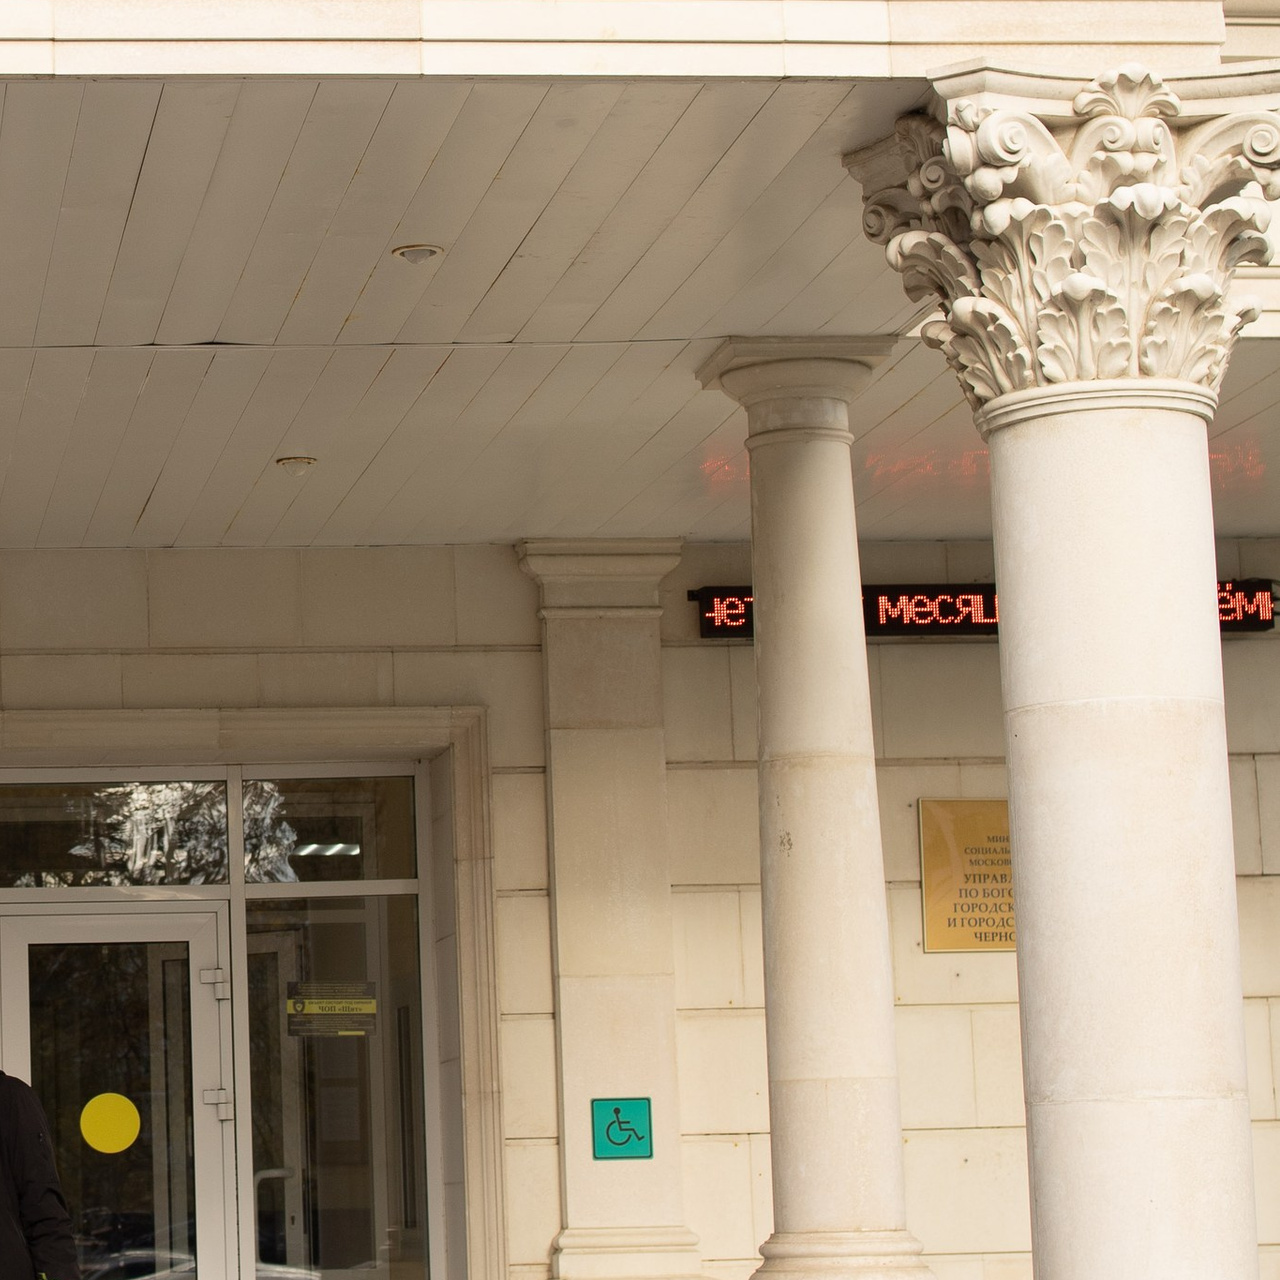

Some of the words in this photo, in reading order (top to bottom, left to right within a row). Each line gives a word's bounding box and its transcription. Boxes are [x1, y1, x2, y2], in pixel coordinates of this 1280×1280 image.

[969, 858, 1012, 866] МОСКОВ
[958, 888, 979, 898] ПО
[953, 903, 1015, 914] ГОРОДСК
[947, 917, 957, 928] И
[960, 917, 1015, 929] ГОРОДС
